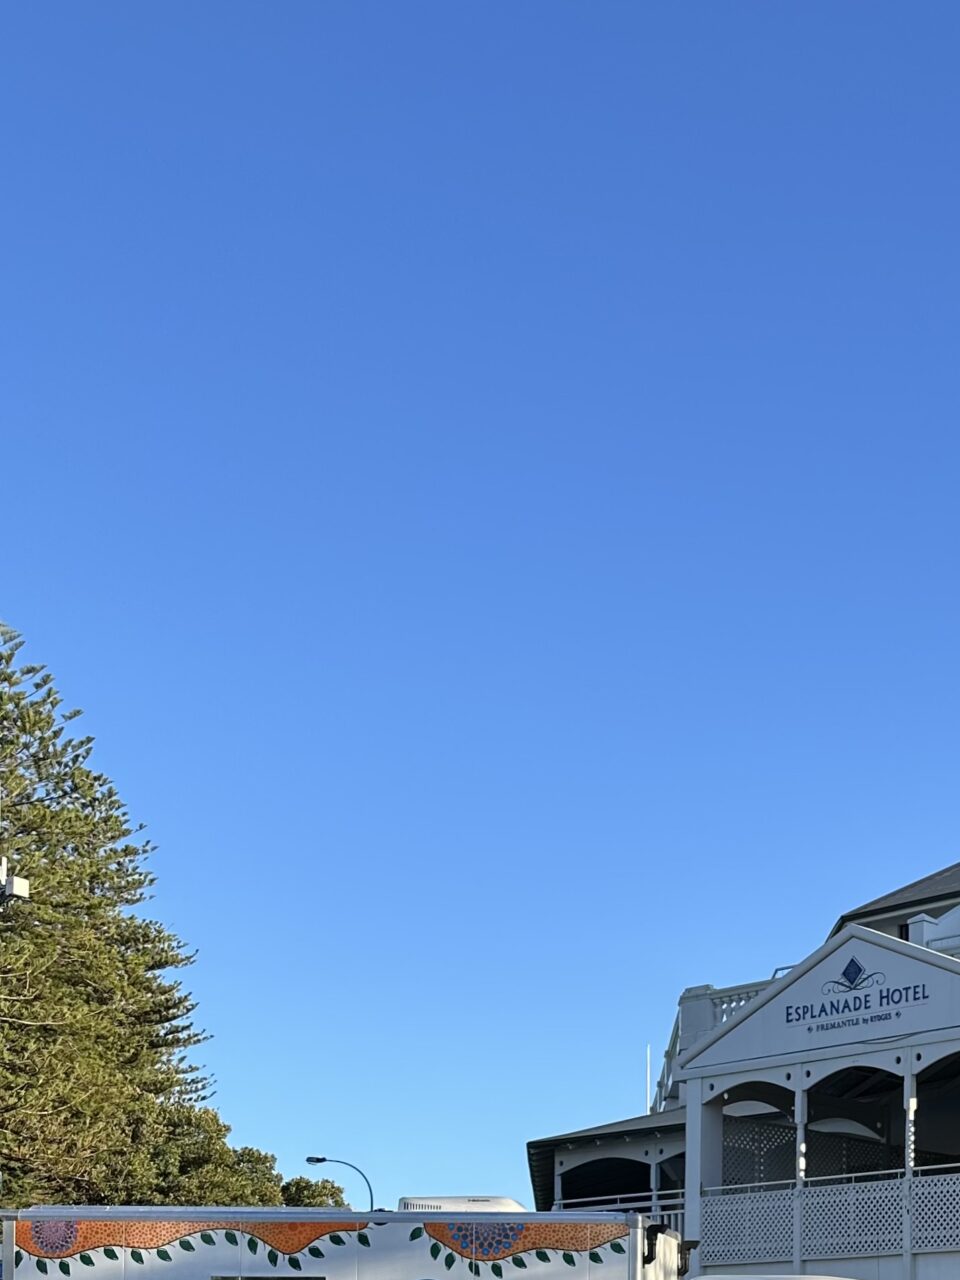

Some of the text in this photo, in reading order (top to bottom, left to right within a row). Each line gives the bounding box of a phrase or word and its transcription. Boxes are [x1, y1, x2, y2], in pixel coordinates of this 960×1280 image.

[786, 984, 930, 1023] ESPLANADE HOTEL
[816, 1013, 892, 1032] FREMANTLE by RYDGES
